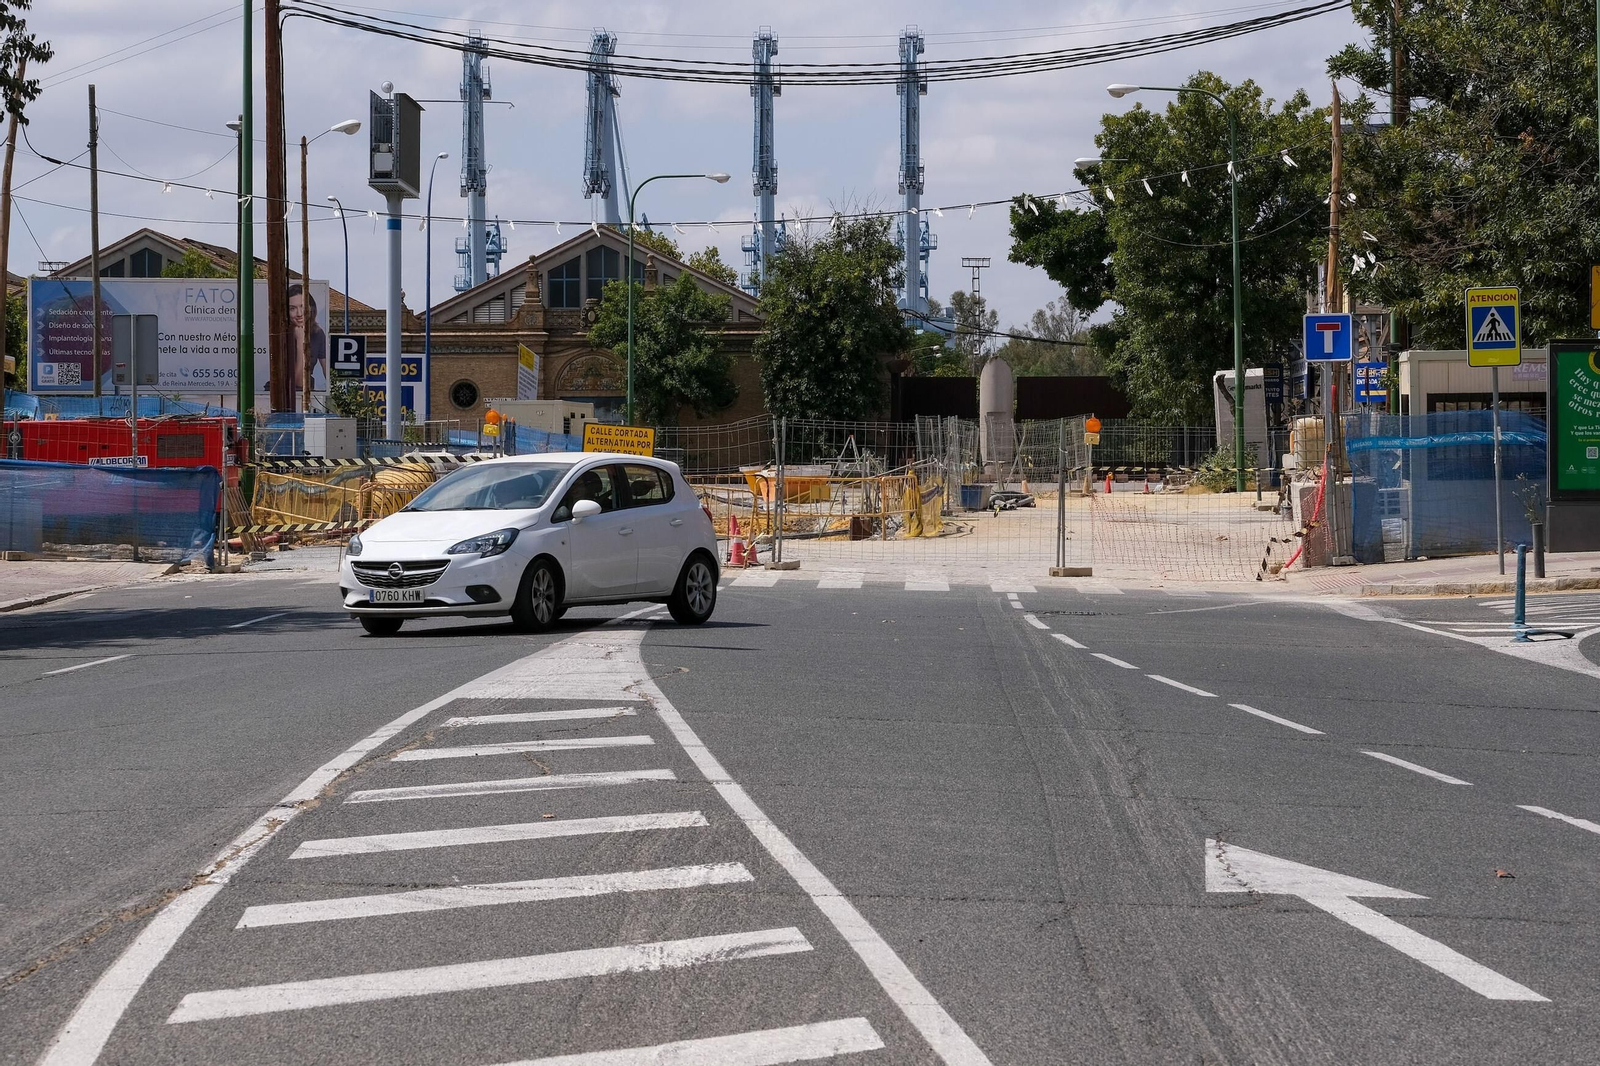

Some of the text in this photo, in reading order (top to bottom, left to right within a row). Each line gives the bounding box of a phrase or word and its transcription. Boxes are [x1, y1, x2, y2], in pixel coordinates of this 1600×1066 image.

[185, 288, 235, 303] FATO
[1470, 293, 1517, 302] ATENCIÓN
[48, 308, 78, 316] Sedación
[184, 305, 237, 314] Clínica den
[48, 335, 93, 343] Implantología
[158, 332, 237, 341] Con nuestro Méto
[179, 345, 188, 354] la
[190, 345, 210, 354] vida
[192, 369, 210, 378] 655
[213, 369, 225, 378] 56
[227, 369, 238, 378] 80
[1574, 368, 1591, 385] Hay
[1569, 378, 1588, 394] cree
[1572, 393, 1583, 402] se
[1568, 400, 1593, 416] otros
[590, 427, 648, 438] CALLE CORTADA
[586, 437, 651, 449] ALTERNATIVA POR
[375, 590, 421, 601] 0760 KHW
